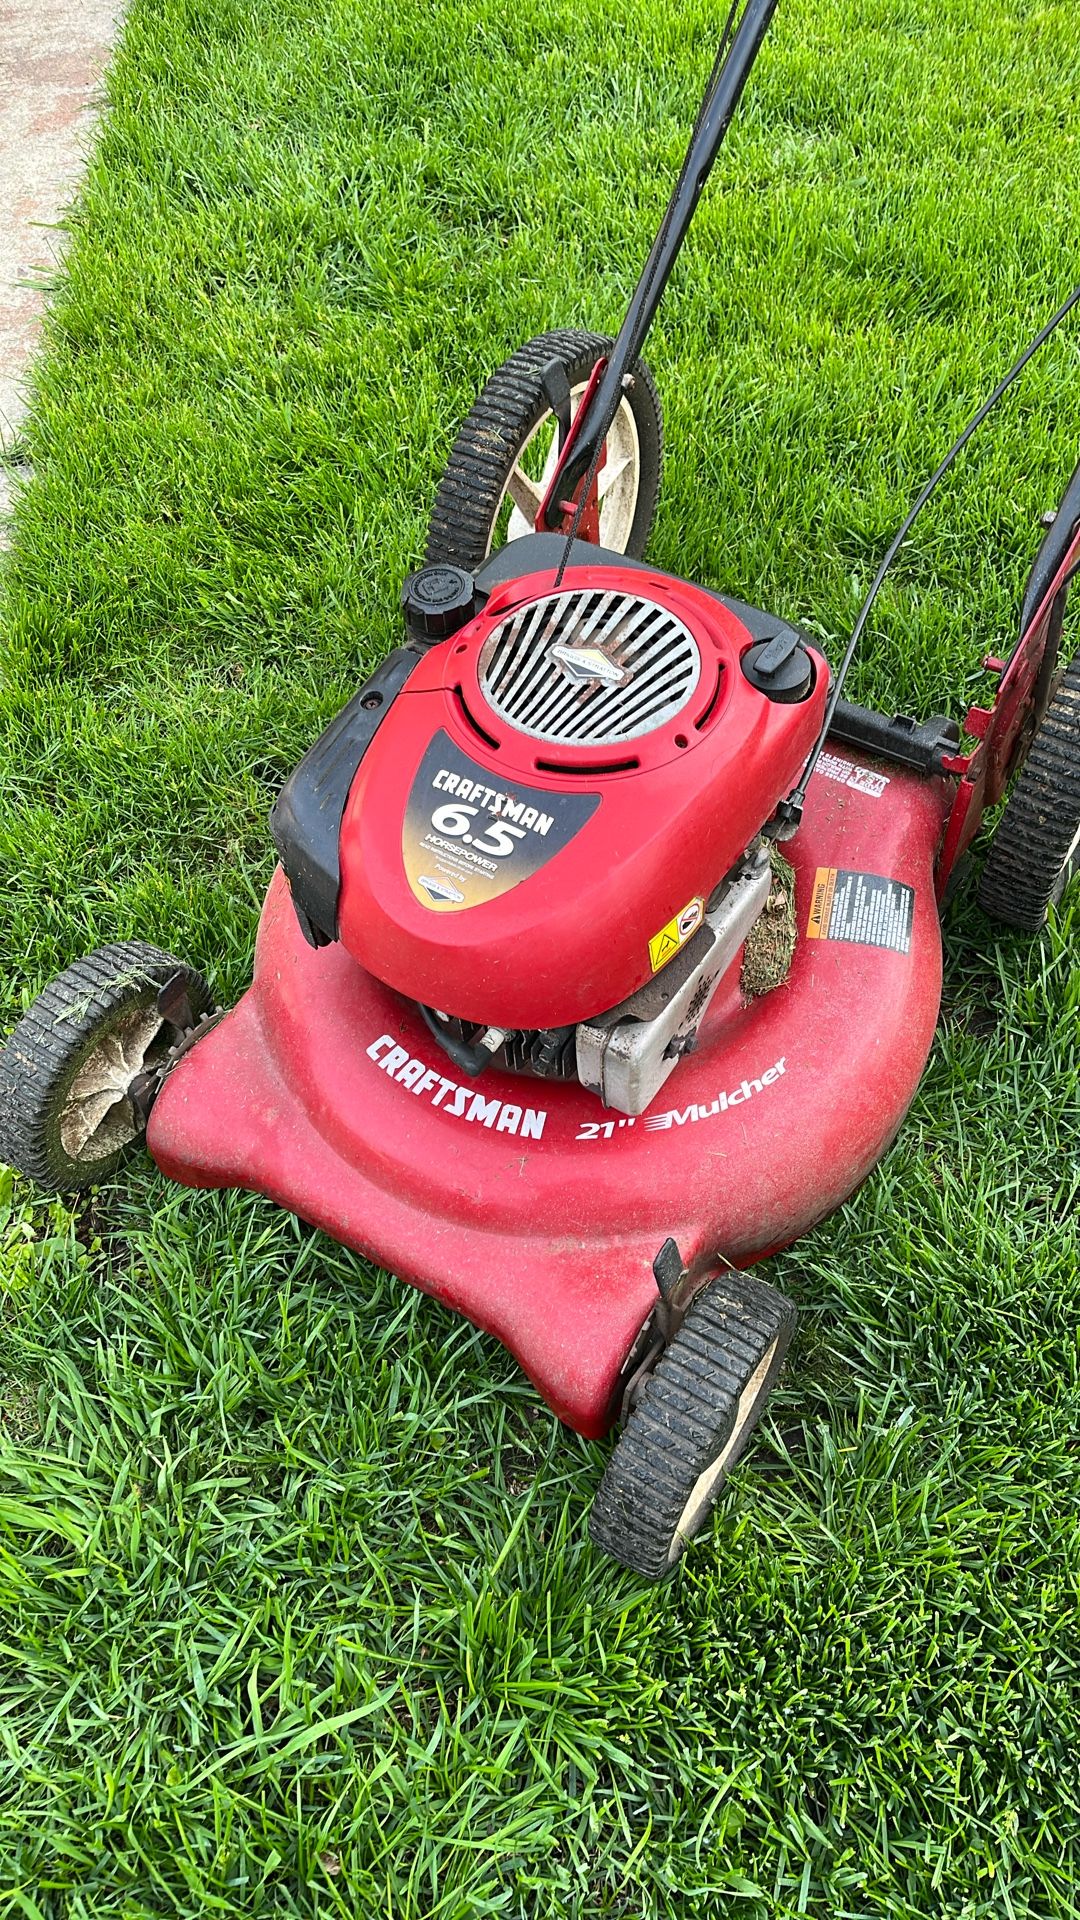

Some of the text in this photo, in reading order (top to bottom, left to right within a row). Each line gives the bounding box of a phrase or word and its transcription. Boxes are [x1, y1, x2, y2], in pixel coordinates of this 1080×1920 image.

[431, 803, 527, 857] 6.5
[432, 770, 555, 836] CRAFTSMAN
[424, 834, 498, 872] HORSEPOWER
[434, 863, 460, 879] Powered
[813, 883, 826, 915] WARNING
[365, 1034, 547, 1140] CRAFTSMAN
[575, 1056, 788, 1140] 21" Mulcher
